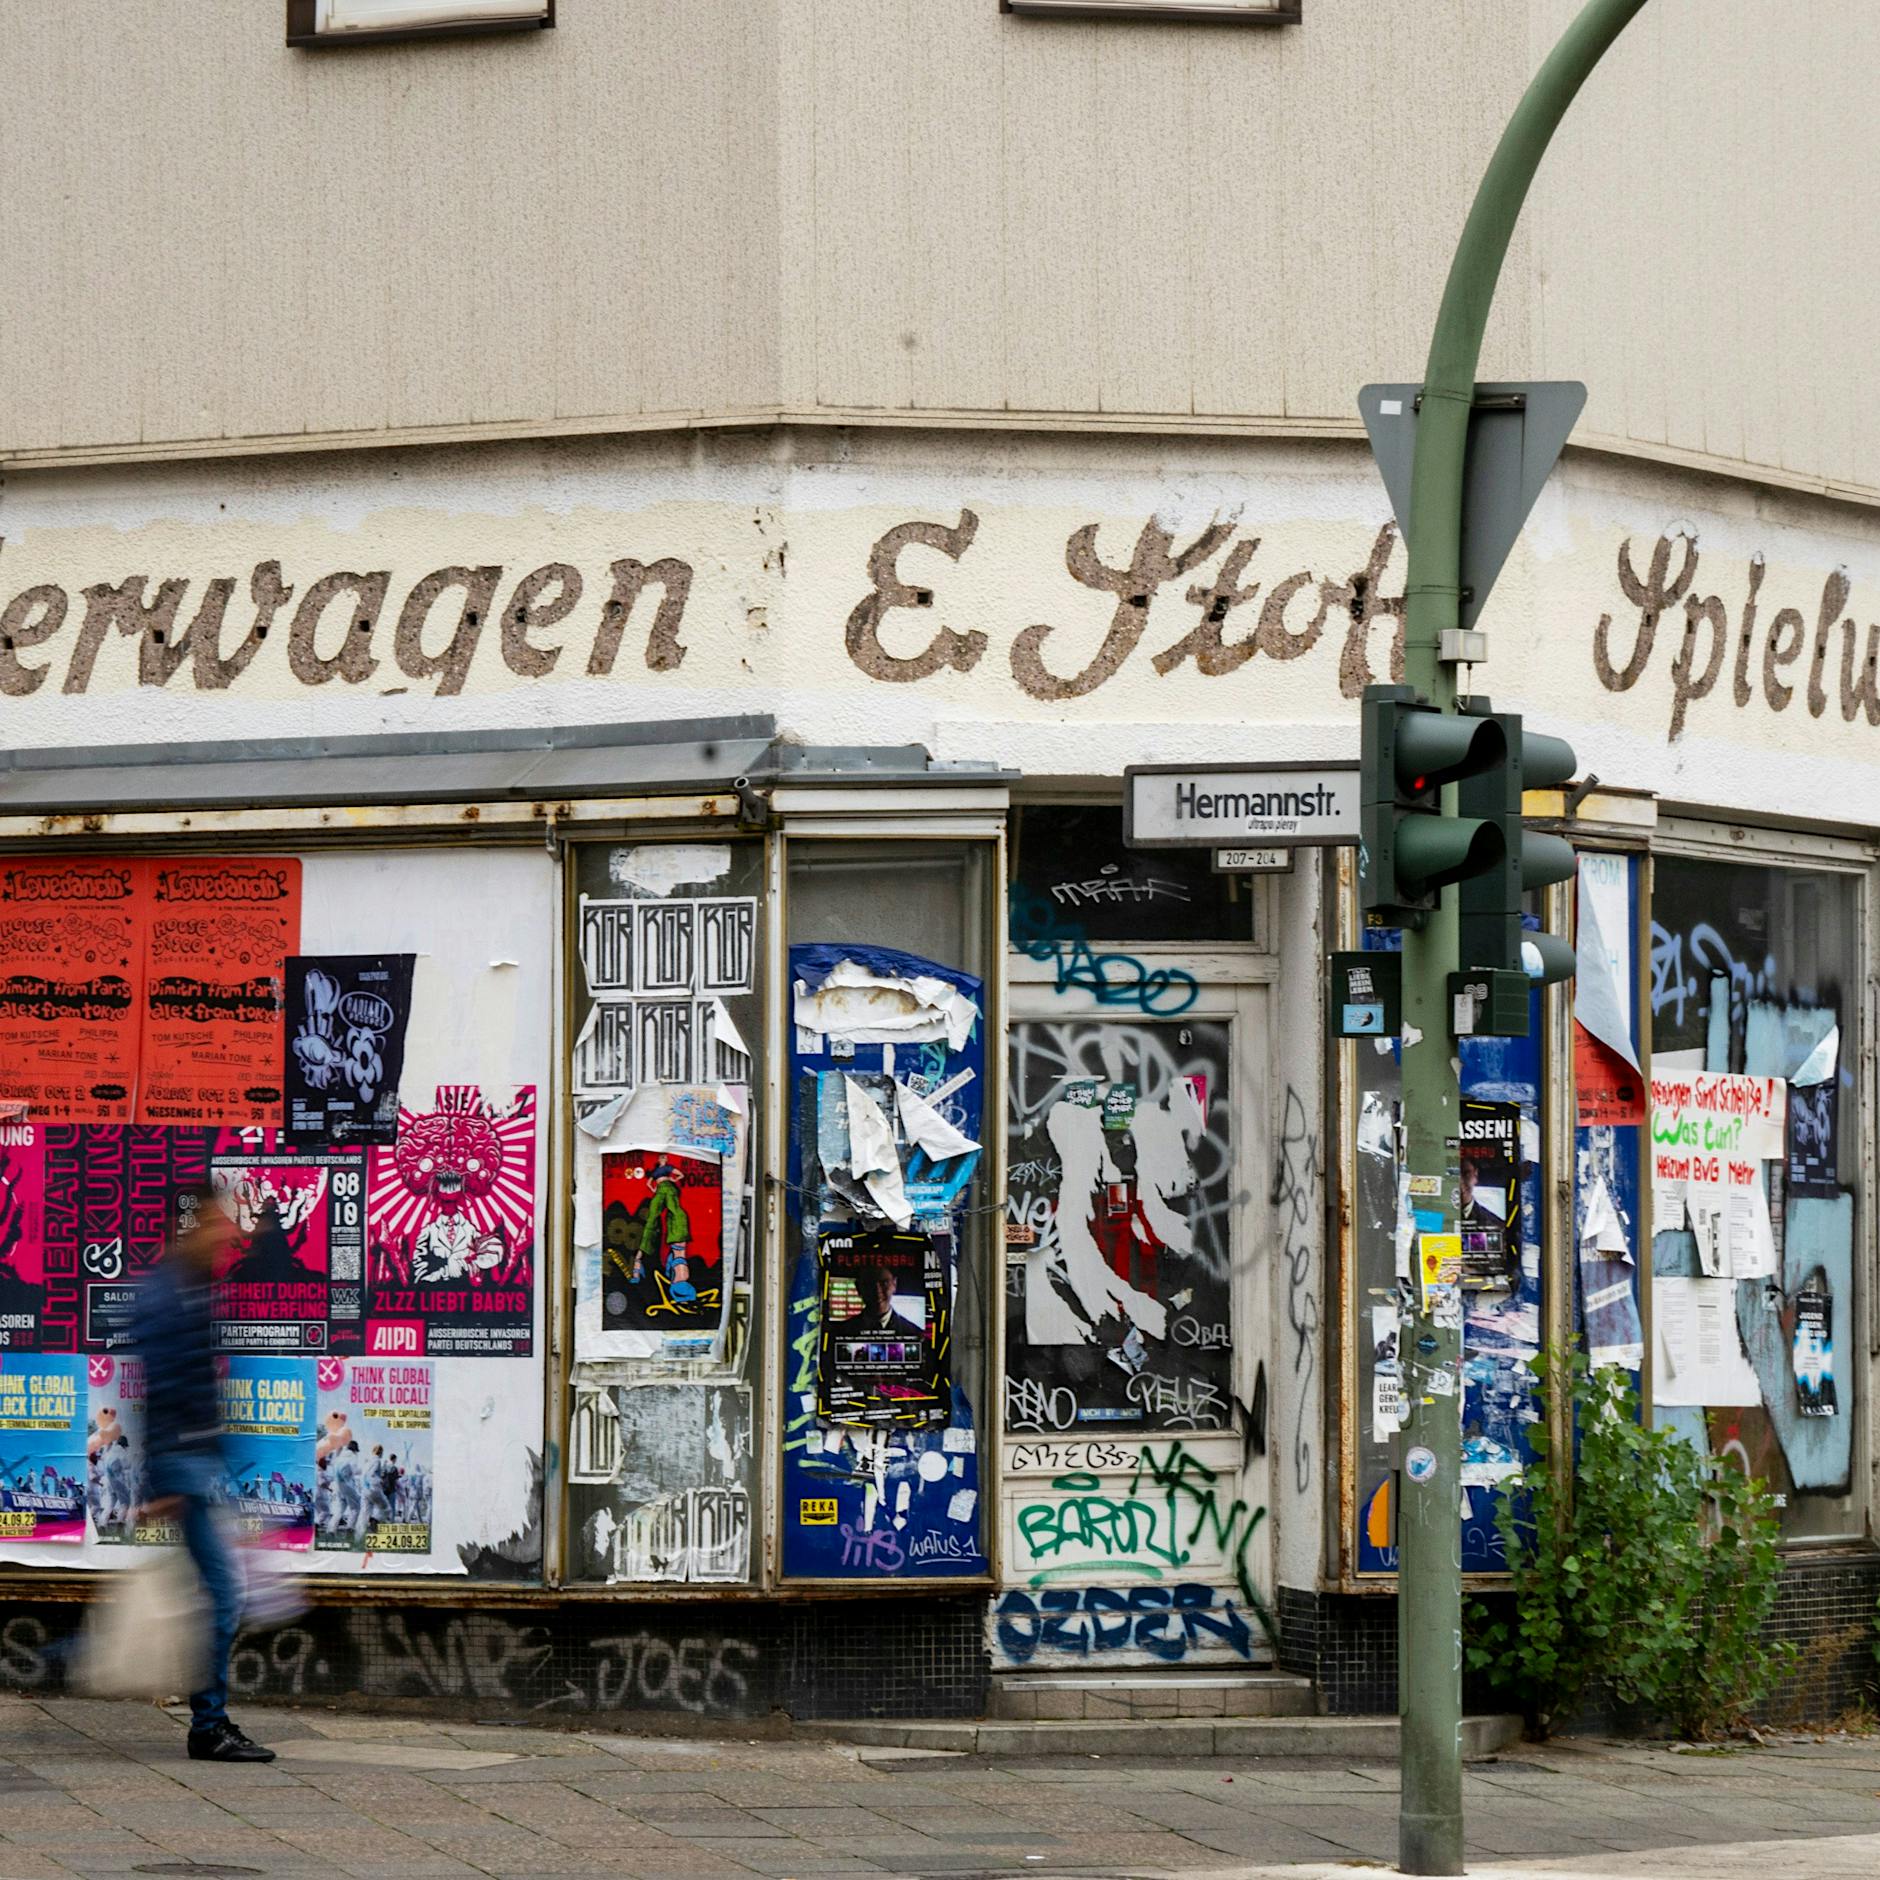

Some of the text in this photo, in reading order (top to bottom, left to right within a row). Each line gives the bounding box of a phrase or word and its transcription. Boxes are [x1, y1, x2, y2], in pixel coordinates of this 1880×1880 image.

[1176, 782, 1342, 820] Hermannstr.
[1367, 913, 1383, 926] F3
[54, 977, 88, 998] from
[207, 978, 243, 999] from
[1652, 1111, 1743, 1152] Was tun?
[278, 1282, 327, 1300] DURCH
[374, 1291, 417, 1312] ZLZZ
[419, 1291, 468, 1312] LIEBT
[472, 1291, 527, 1313] BABYS
[0, 1314, 35, 1329] SOREN
[221, 1325, 300, 1338] PARTEIPROGRAMM
[428, 1328, 530, 1339] AUSSERIRDISCHE INVASOREN
[428, 1340, 513, 1350] PARTEI DEUTSCHLANDS
[30, 1375, 76, 1396] GLOBAL
[352, 1366, 431, 1386] THINK GLOBAL
[258, 1379, 306, 1401] GLOBAL
[350, 1386, 430, 1405] BLOCK LOCAL!
[32, 1397, 76, 1417] LOCAL!
[259, 1401, 304, 1422] LOCAL!
[802, 1500, 836, 1512] REKA
[366, 1534, 427, 1549] 22.-24.09.23
